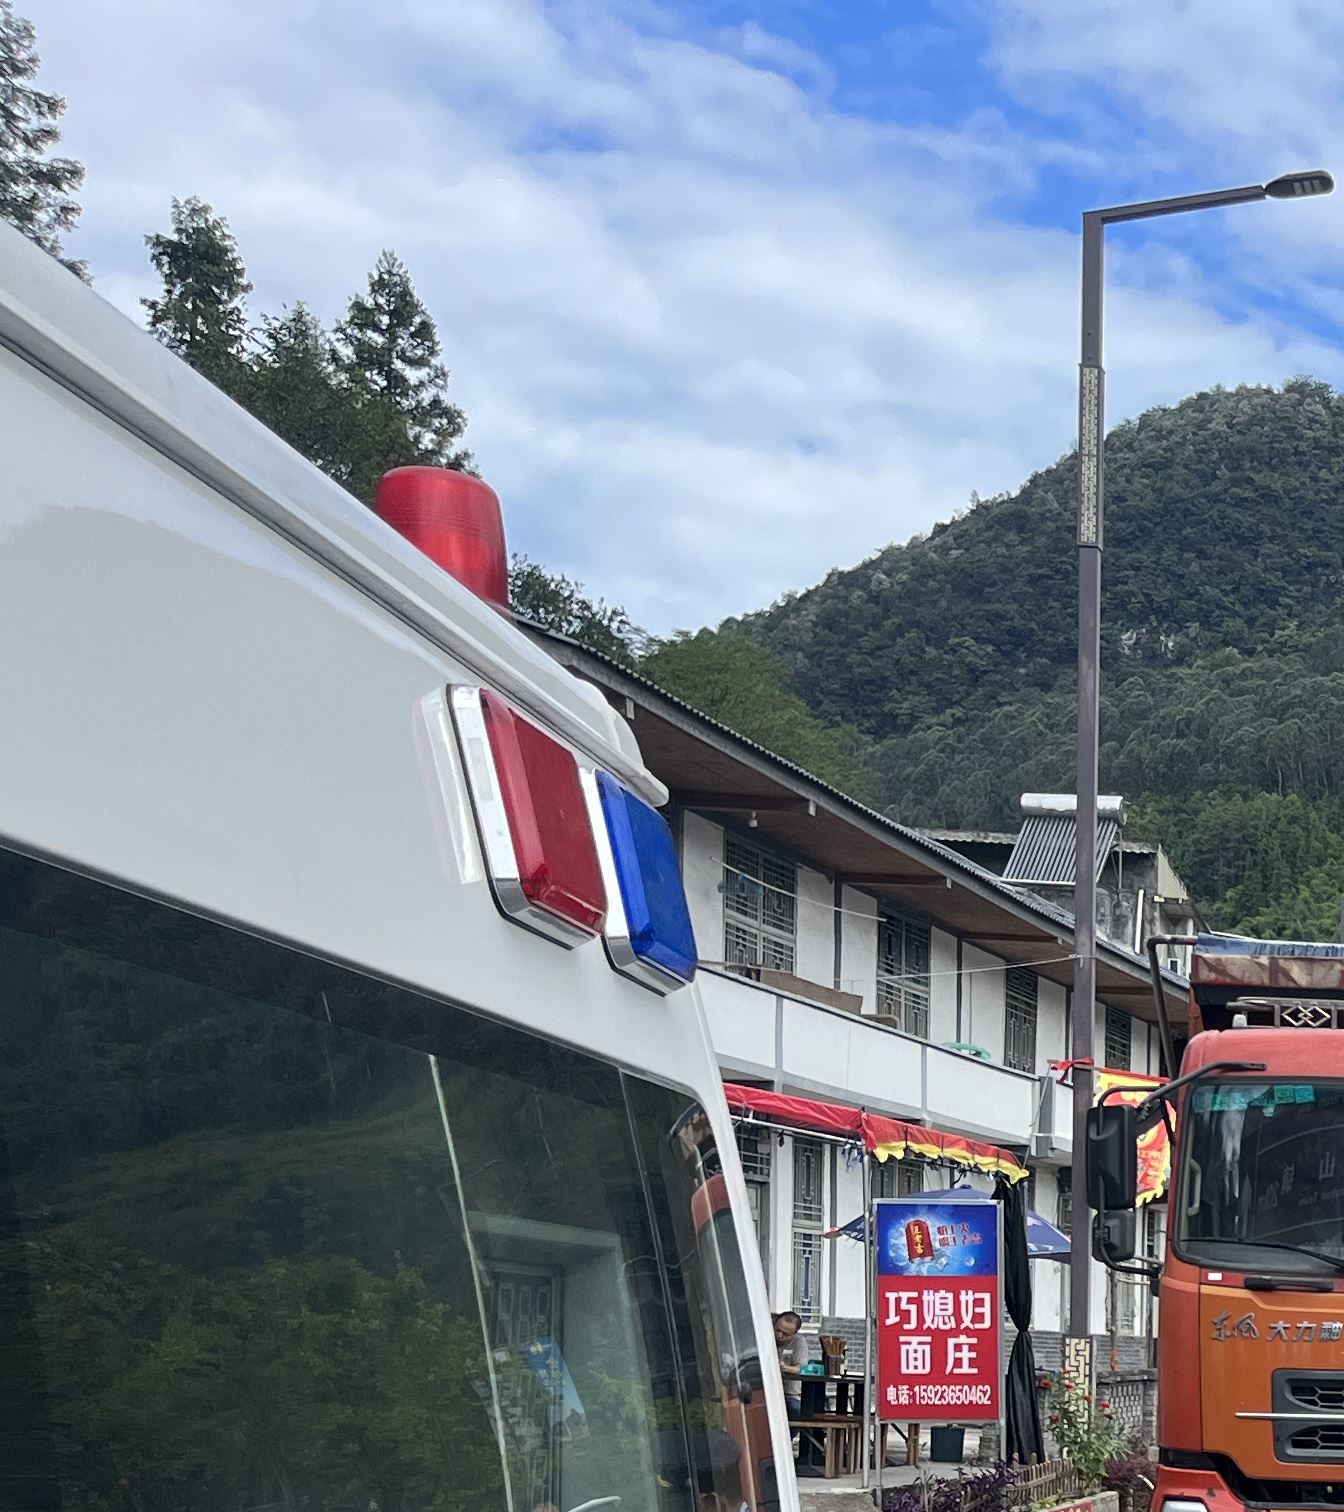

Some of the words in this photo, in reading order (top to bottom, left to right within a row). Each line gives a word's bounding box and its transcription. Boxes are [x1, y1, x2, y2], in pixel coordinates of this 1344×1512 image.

[885, 1290, 992, 1330] 巧媳妇
[1266, 1320, 1343, 1341] 大力神
[899, 1335, 978, 1375] 面庄
